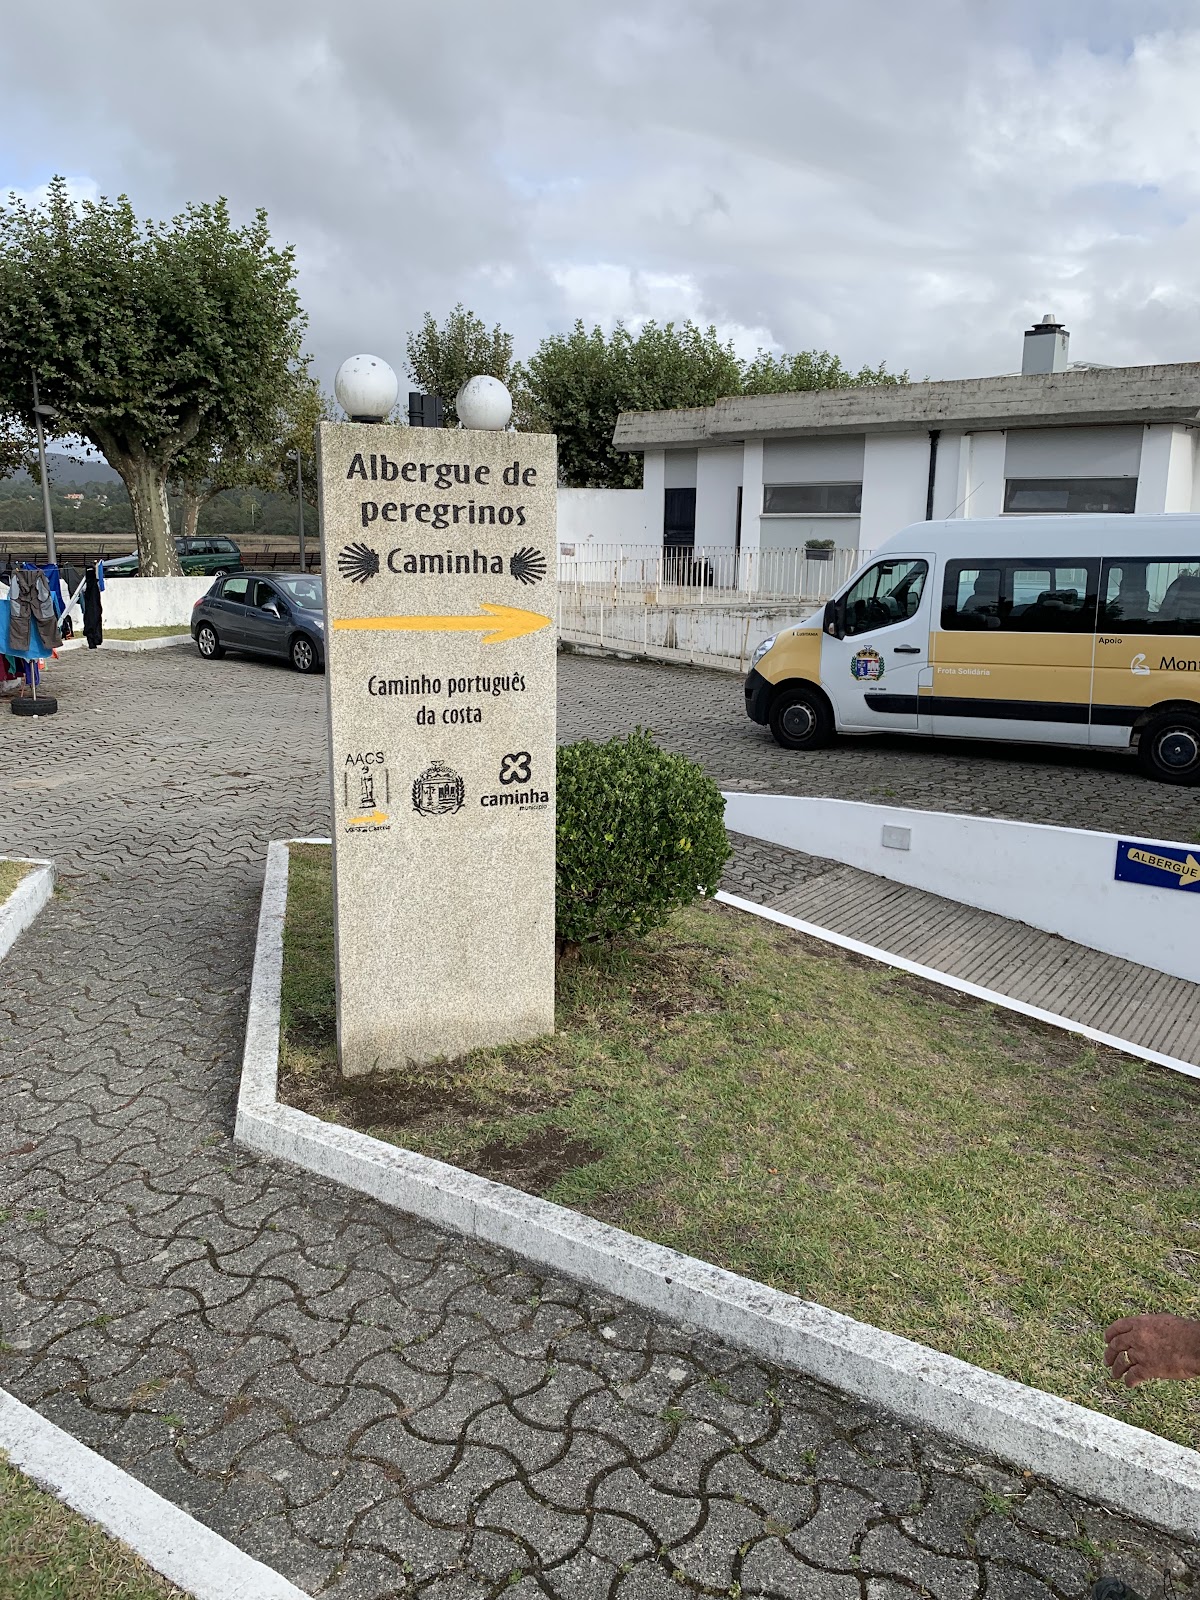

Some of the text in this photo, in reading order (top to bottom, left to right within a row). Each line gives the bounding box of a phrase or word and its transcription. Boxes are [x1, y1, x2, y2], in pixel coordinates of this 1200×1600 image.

[346, 453, 537, 490] Albergue de
[361, 499, 526, 530] peregrinos
[387, 547, 504, 575] Caminha
[1098, 636, 1123, 646] Apoio
[937, 667, 991, 676] Frota Solidária
[1159, 656, 1200, 671] Mon
[367, 671, 527, 698] Caminho português
[416, 705, 482, 726] da costa
[344, 751, 385, 766] AACS
[480, 788, 550, 807] caminha
[1132, 851, 1199, 878] ALBERGUE
